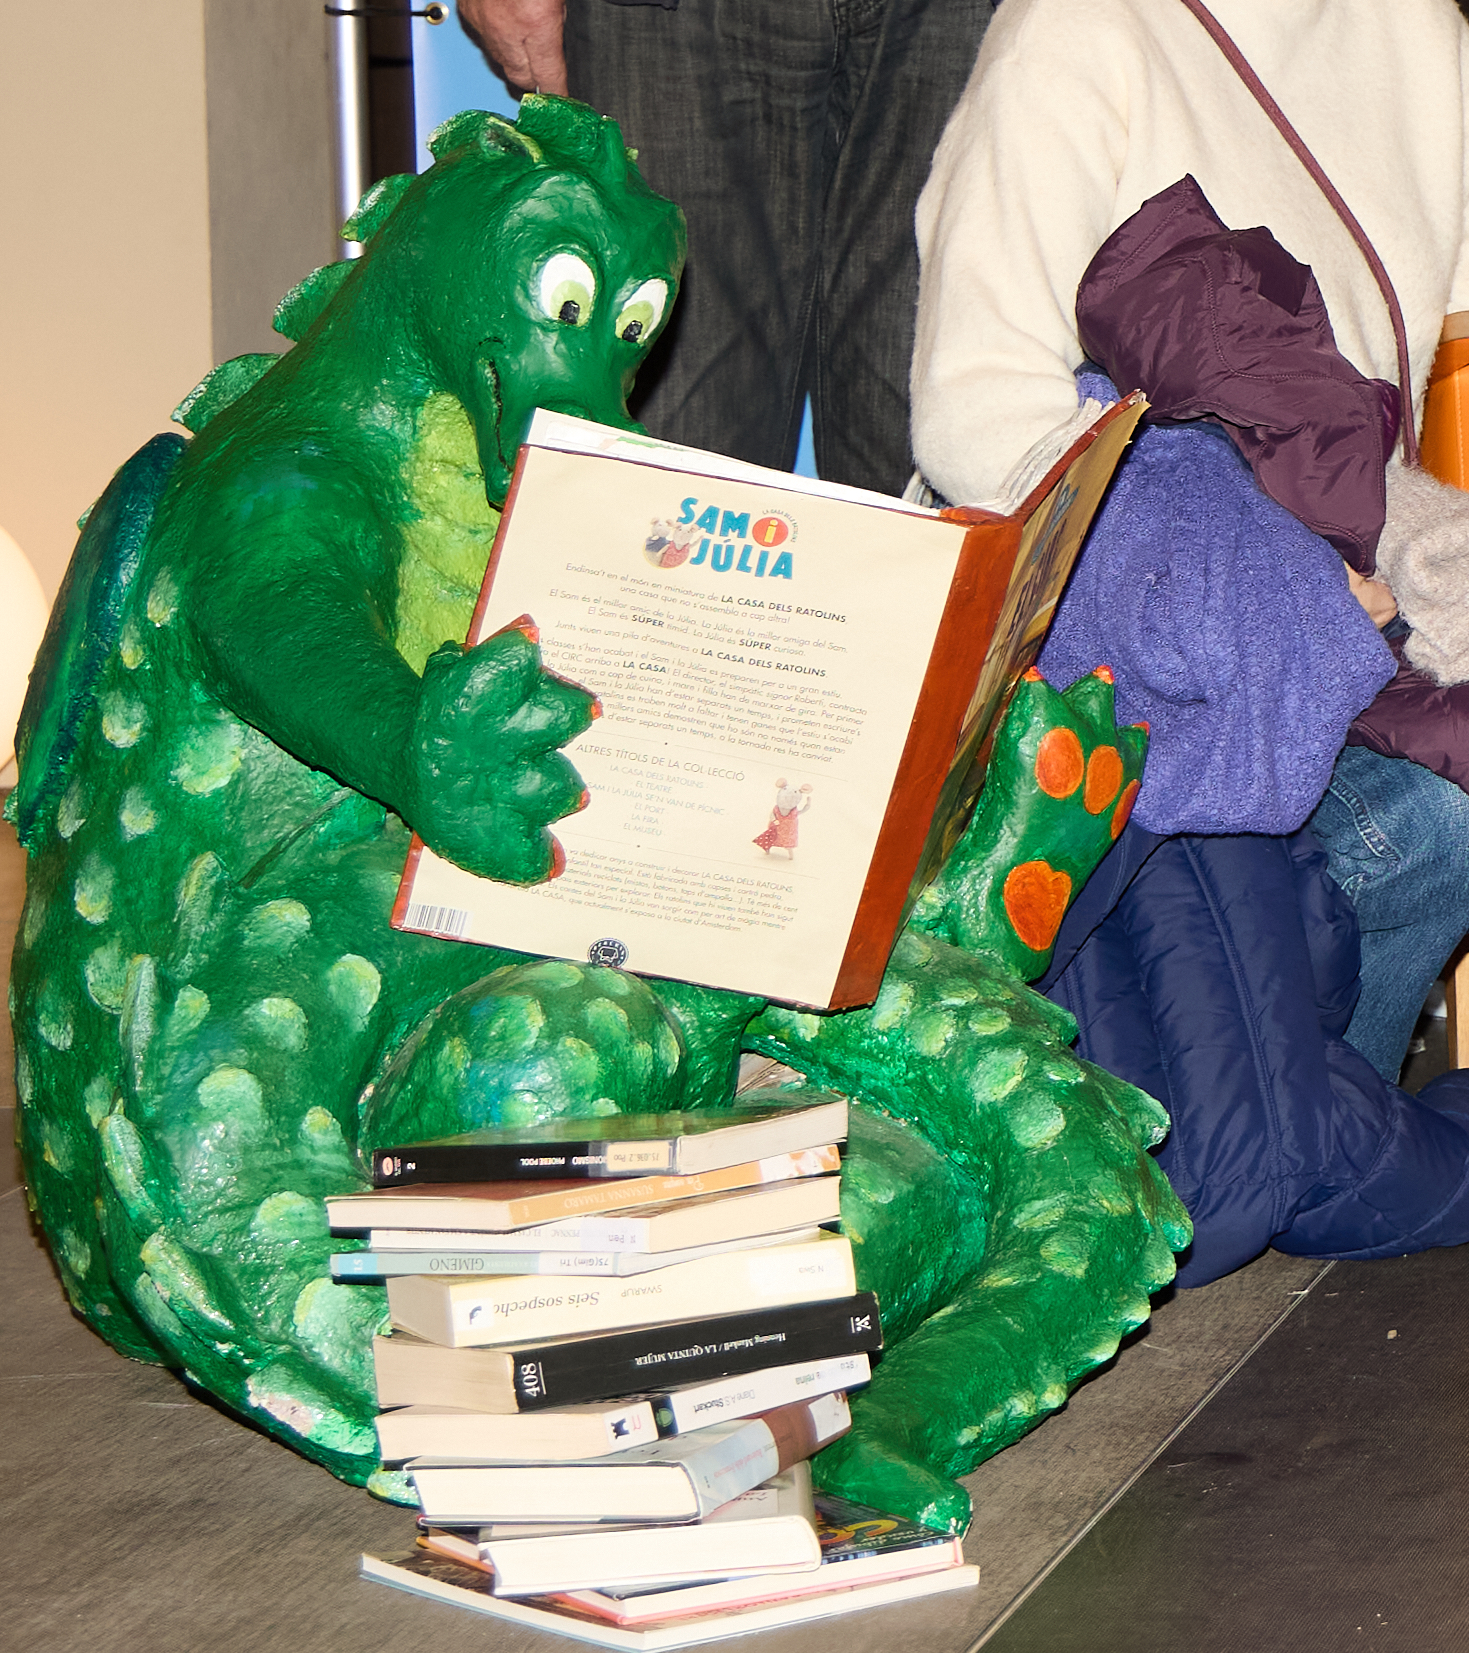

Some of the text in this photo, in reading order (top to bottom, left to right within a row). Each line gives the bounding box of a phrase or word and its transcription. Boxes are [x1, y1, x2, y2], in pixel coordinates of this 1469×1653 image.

[677, 497, 751, 539] SAM
[765, 519, 779, 542] i
[689, 538, 794, 580] JÚLIA
[720, 595, 734, 603] LA
[737, 597, 765, 609] CASA
[768, 601, 792, 613] DELS
[631, 612, 665, 627] SÚPER
[738, 636, 772, 651] SÚPER
[700, 648, 713, 656] LA
[716, 651, 745, 663] CASA
[748, 657, 772, 669] DELS
[574, 741, 612, 757] ALTRES
[615, 747, 649, 763] TÍTOLS
[650, 755, 665, 766] DE
[667, 758, 680, 769] LA
[519, 1156, 566, 1167] PHOEBE POOL
[563, 1192, 607, 1209] TAMARO
[606, 1183, 655, 1201] SUSANNA
[551, 1228, 581, 1238] PENNAC
[608, 1234, 625, 1244] Pen
[430, 1257, 485, 1272] GIMENO
[567, 1290, 601, 1308] Seis
[621, 1284, 663, 1298] SWARUP
[723, 1337, 754, 1351] Mankell
[754, 1331, 787, 1345] Henning
[667, 1345, 704, 1361] QUINTA
[704, 1344, 717, 1354] LA
[634, 1352, 667, 1367] MUJER
[520, 1362, 542, 1399] 408
[693, 1397, 725, 1414] Stuckart
